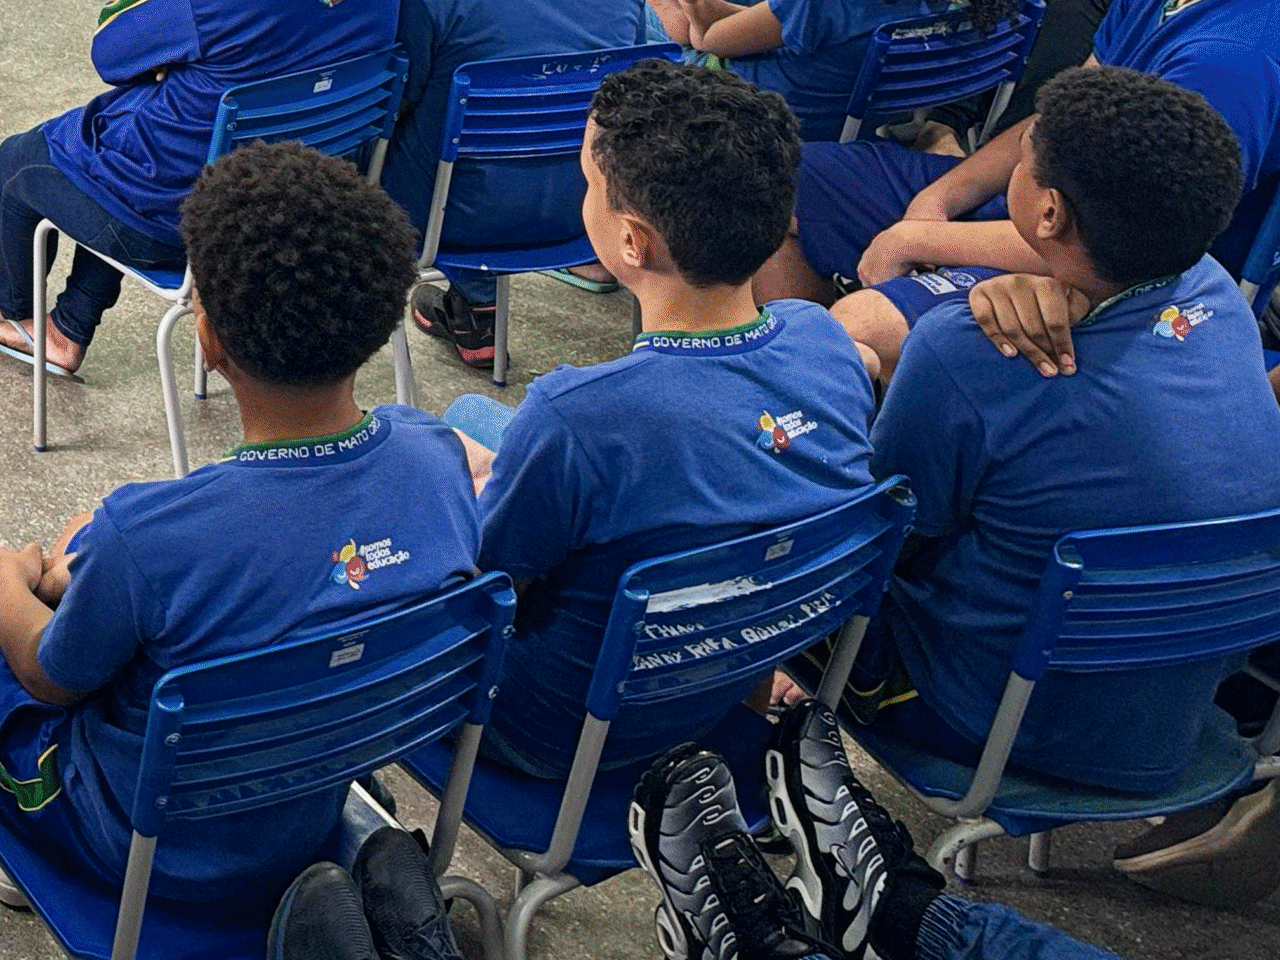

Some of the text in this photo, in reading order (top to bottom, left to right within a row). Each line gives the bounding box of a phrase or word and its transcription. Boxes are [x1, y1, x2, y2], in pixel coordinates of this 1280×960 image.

[653, 336, 721, 349] GOVERNO
[725, 334, 742, 347] DE
[240, 447, 310, 461] GOVERNO
[314, 443, 335, 457] DE
[338, 429, 369, 452] MATO
[365, 547, 391, 561] todos
[367, 550, 410, 570] educação
